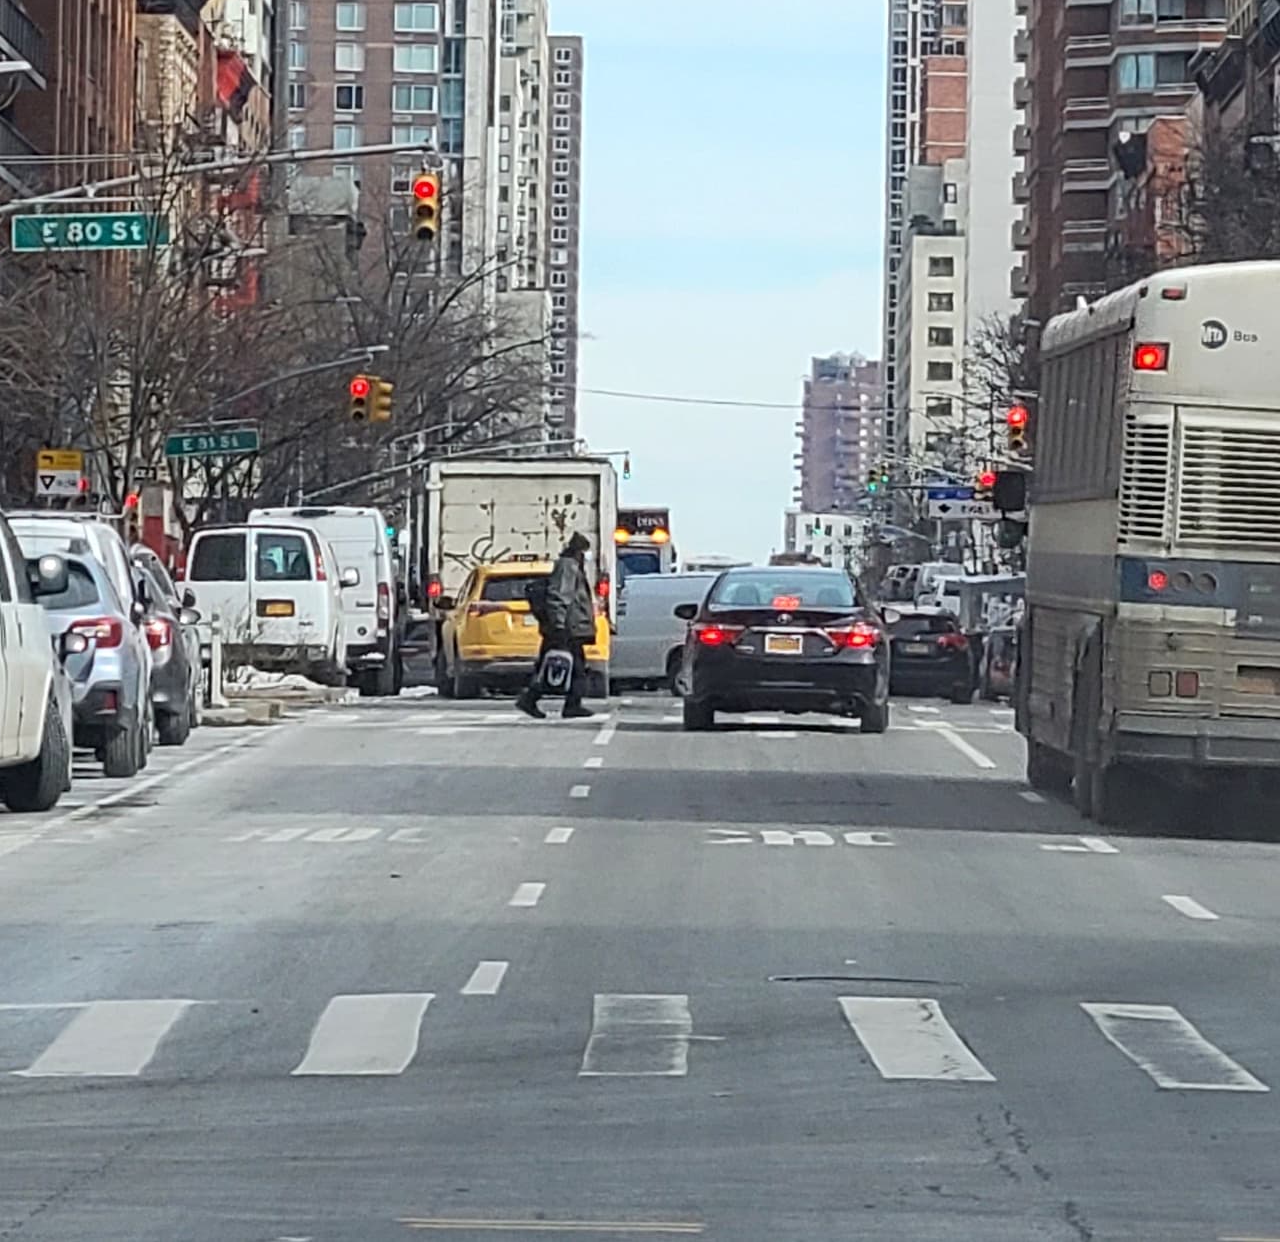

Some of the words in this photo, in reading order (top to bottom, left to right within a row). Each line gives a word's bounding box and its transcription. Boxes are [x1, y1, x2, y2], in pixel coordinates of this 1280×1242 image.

[42, 222, 58, 243] E
[67, 221, 102, 243] 80
[111, 220, 142, 242] St
